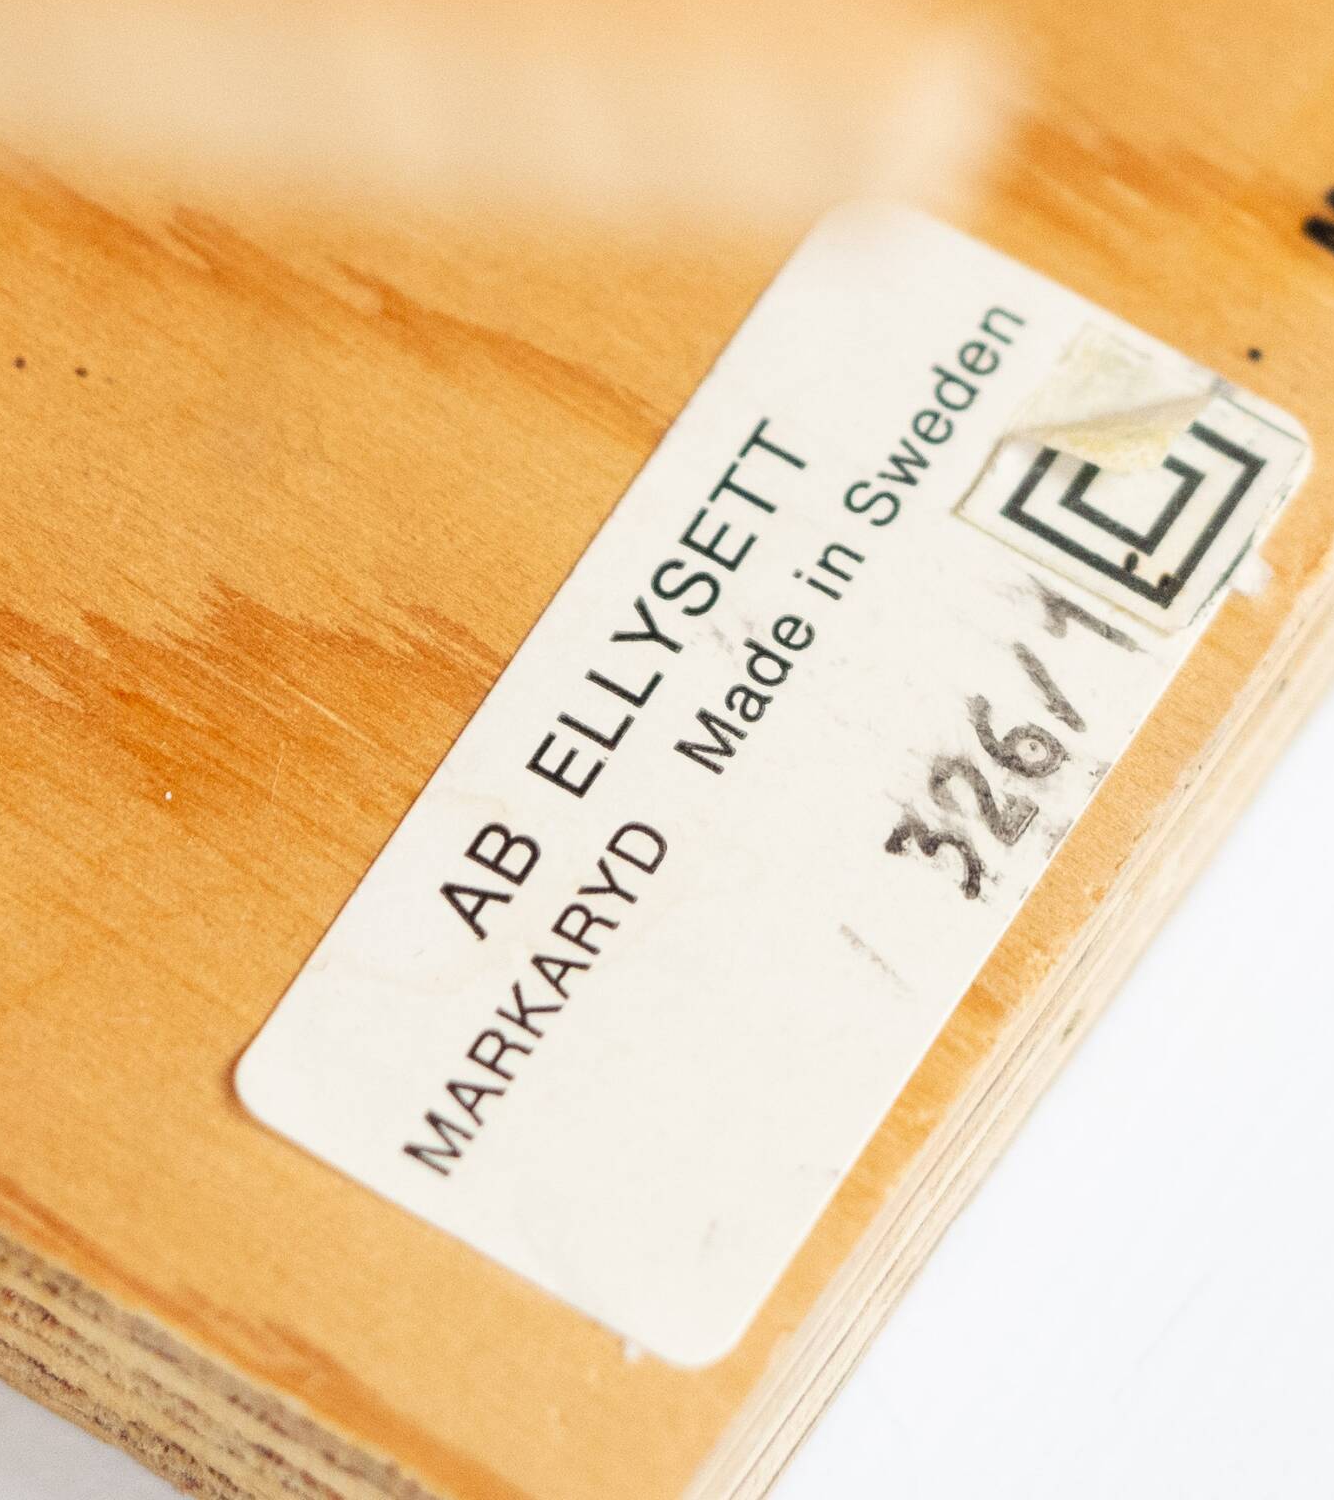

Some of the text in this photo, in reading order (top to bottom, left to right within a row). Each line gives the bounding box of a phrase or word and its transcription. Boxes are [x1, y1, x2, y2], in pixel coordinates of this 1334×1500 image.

[403, 305, 1025, 1176] MARKARYD Made in Sweden
[439, 418, 809, 939] AB ELLYSETT
